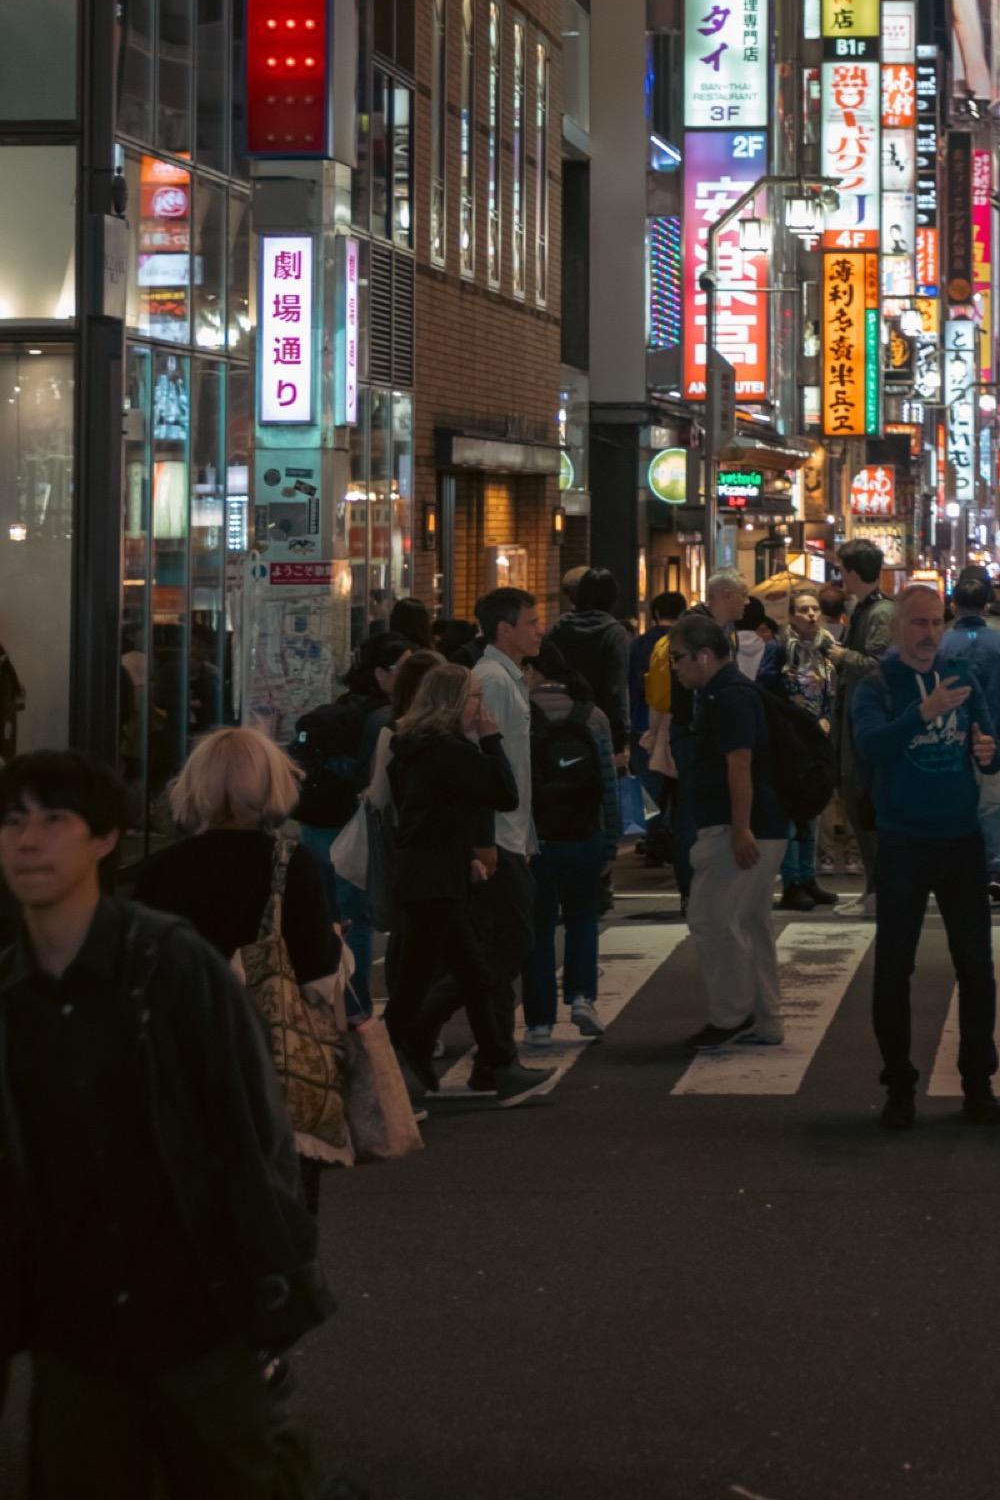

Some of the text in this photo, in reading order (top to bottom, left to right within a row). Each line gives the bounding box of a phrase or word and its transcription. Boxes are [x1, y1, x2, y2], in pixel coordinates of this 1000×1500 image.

[836, 39, 866, 55] B1F
[693, 92, 759, 101] RESTAURANT
[710, 105, 741, 121] 3F
[732, 136, 764, 158] 2F
[836, 231, 865, 246] 4F
[273, 251, 302, 407] 劇場通り
